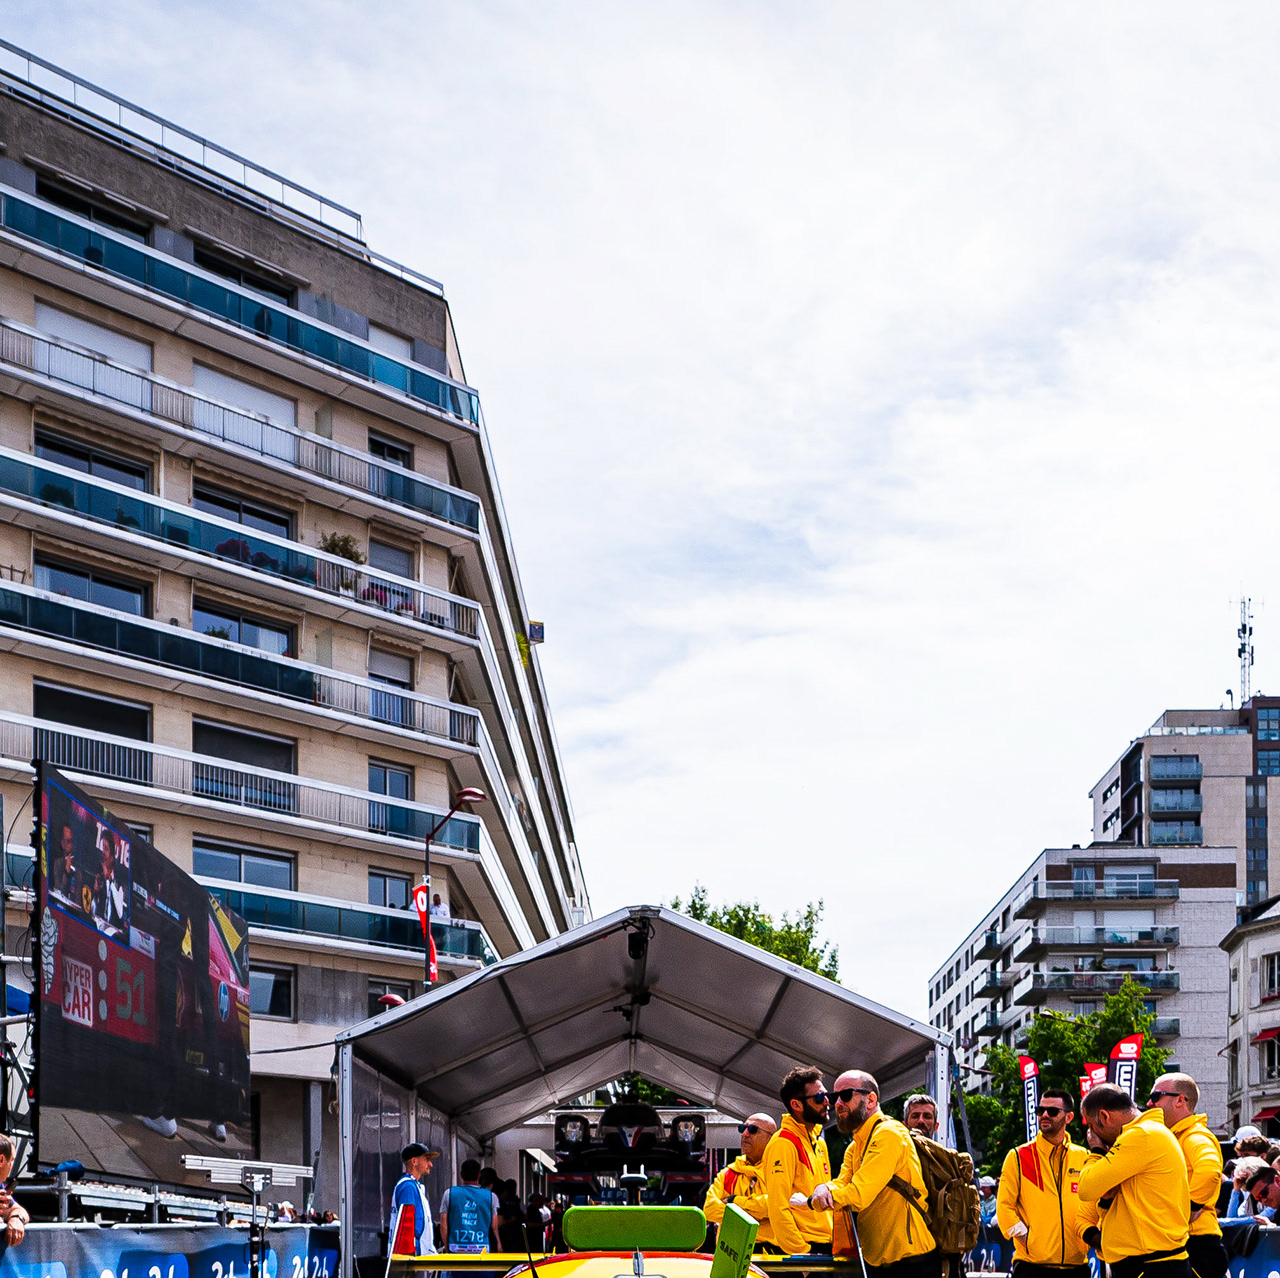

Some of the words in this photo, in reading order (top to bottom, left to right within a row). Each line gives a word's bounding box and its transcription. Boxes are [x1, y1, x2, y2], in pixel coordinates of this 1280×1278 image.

[116, 956, 149, 1027] 51
[454, 1229, 485, 1243] 1278
[719, 1240, 740, 1263] SAFE
